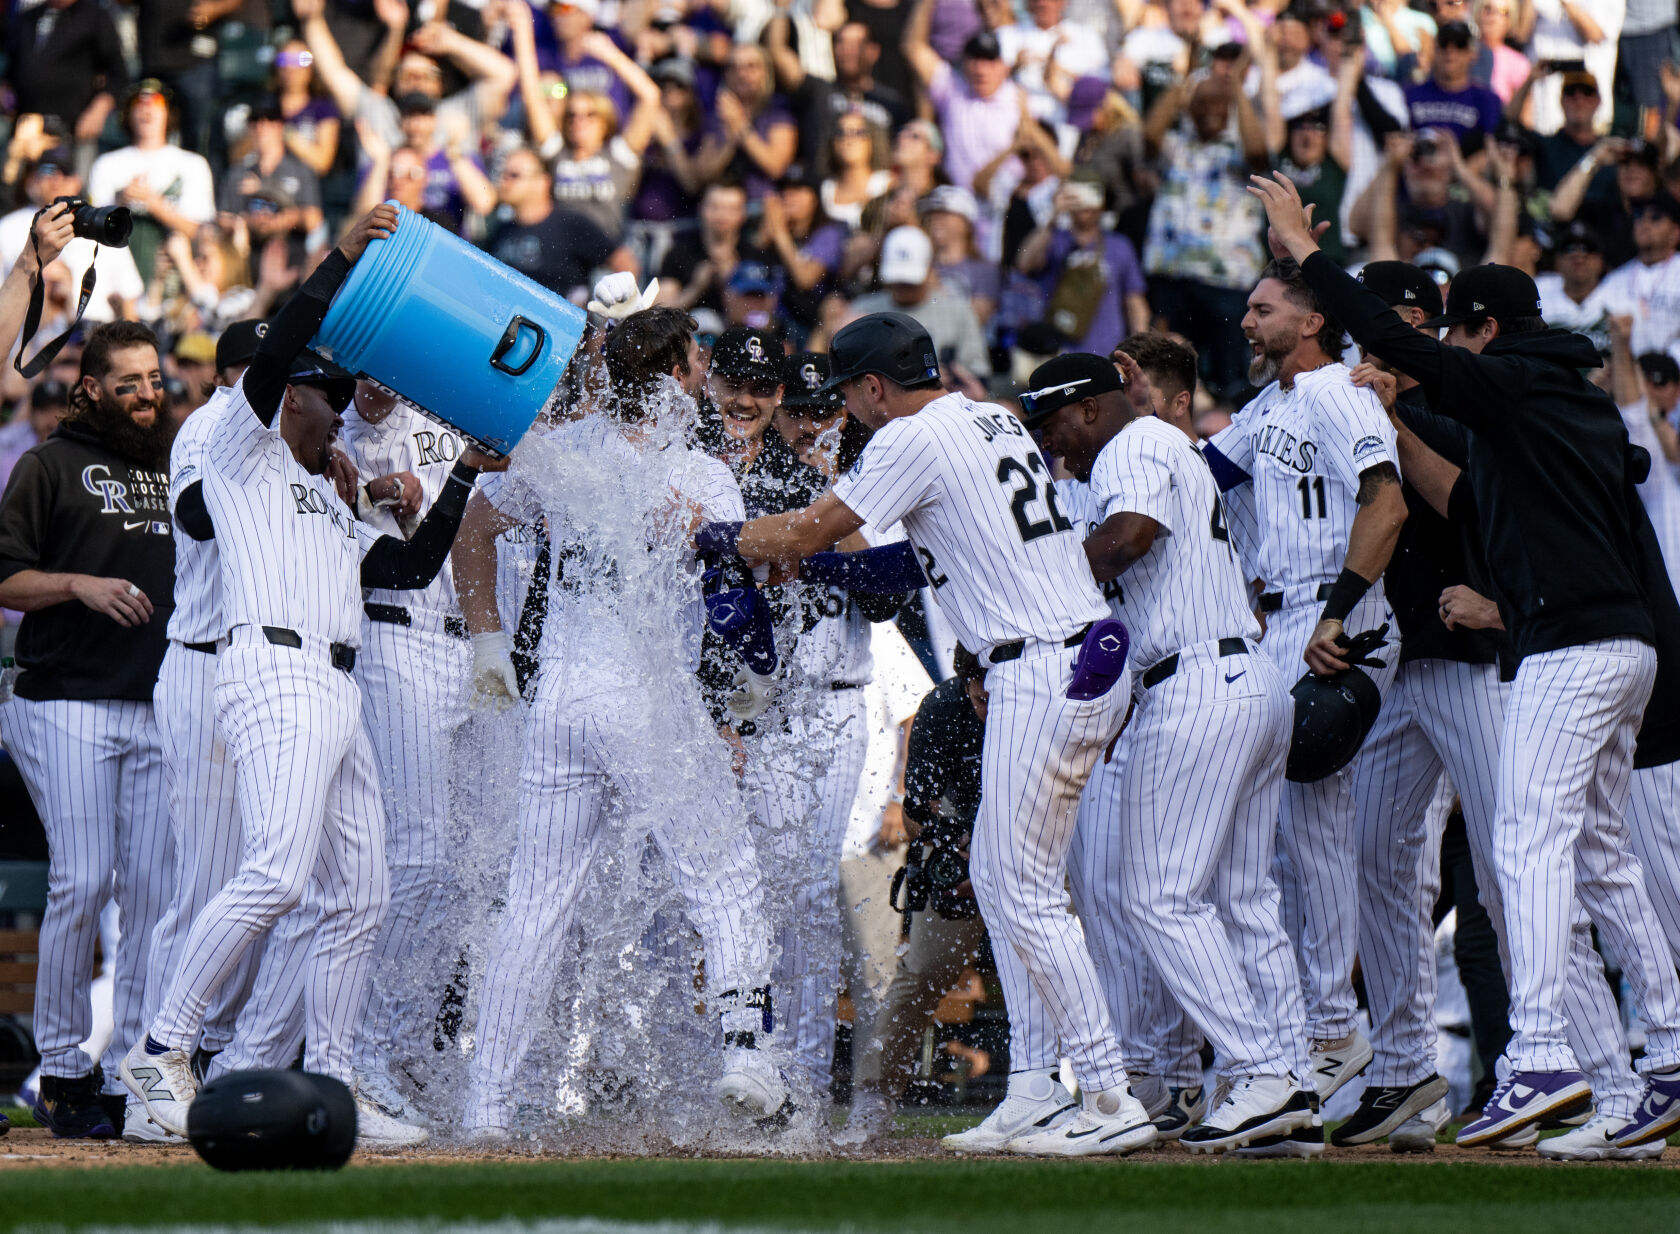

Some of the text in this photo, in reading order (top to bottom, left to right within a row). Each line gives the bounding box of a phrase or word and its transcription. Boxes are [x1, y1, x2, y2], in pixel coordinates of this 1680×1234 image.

[366, 376, 500, 458] POWERADE
[82, 464, 135, 514] CR
[996, 451, 1075, 543] 22
[1297, 475, 1327, 519] 11
